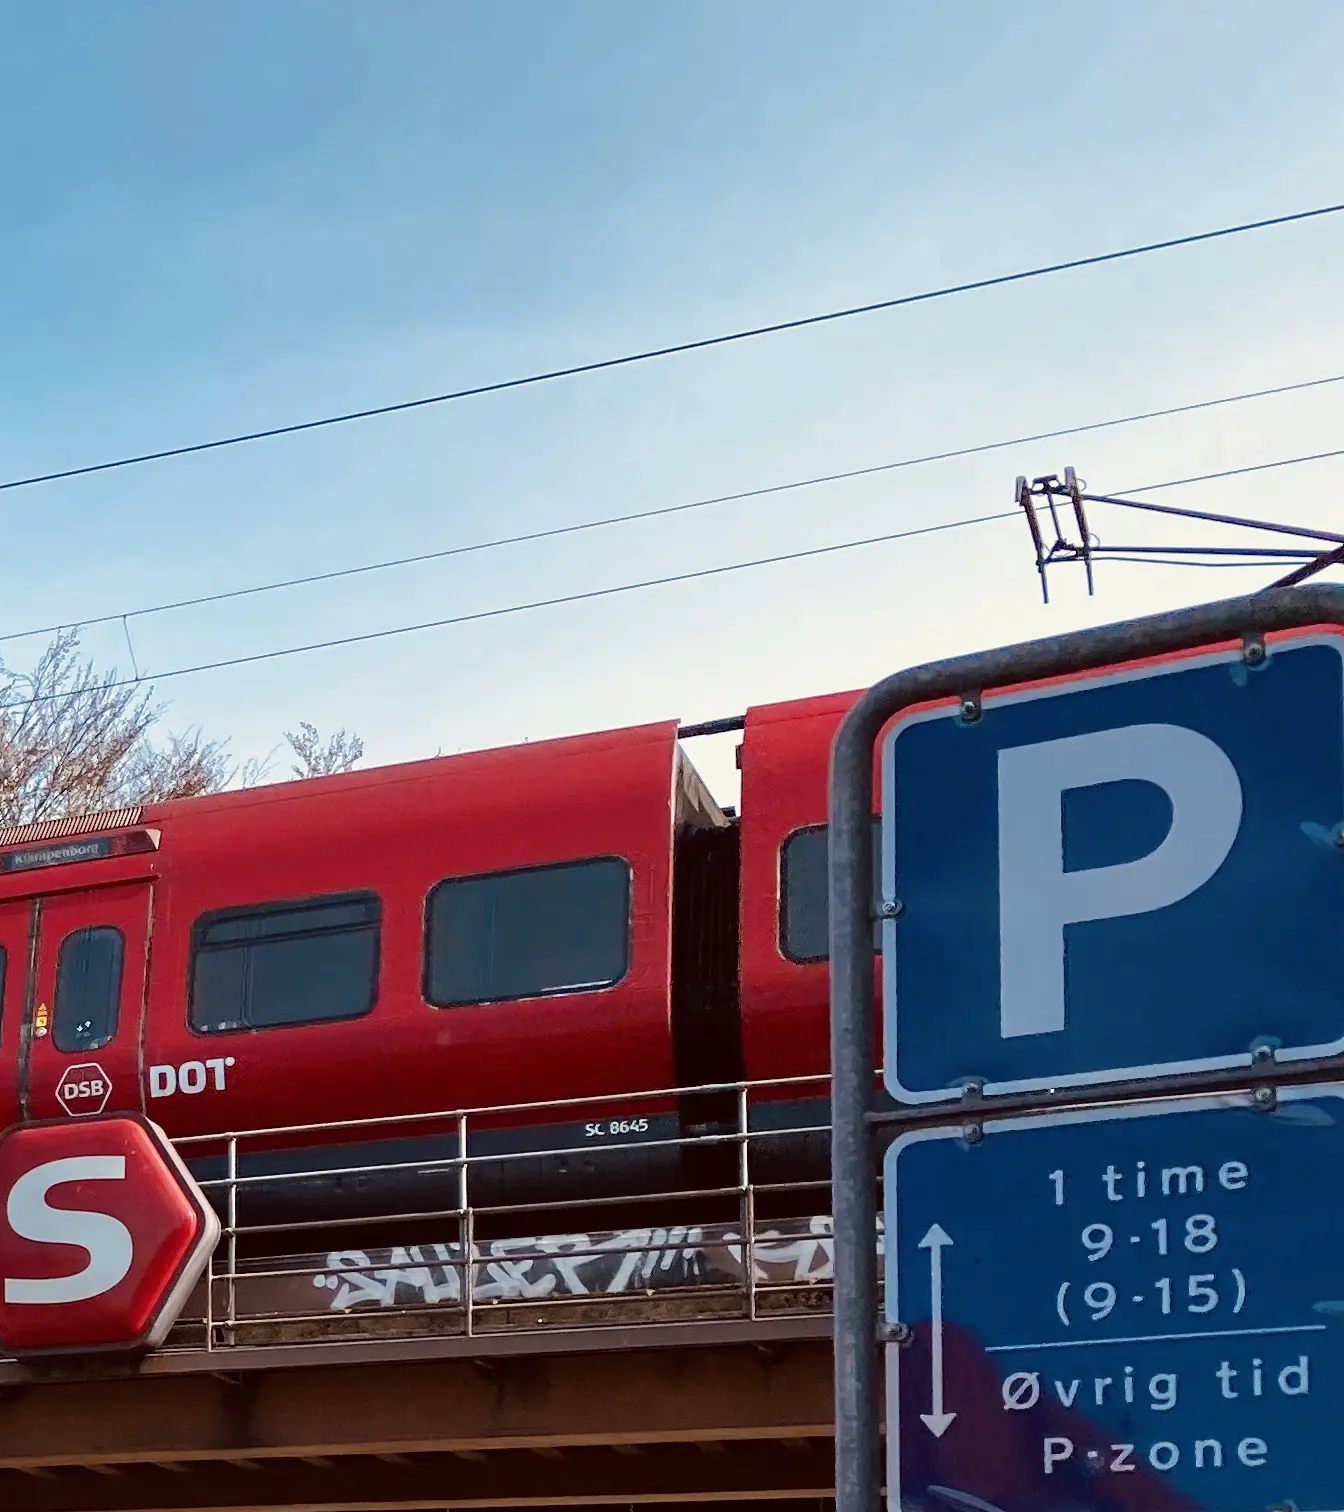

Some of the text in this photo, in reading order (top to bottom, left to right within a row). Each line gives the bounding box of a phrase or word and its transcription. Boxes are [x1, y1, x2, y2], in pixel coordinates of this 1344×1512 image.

[998, 723, 1243, 1038] P
[64, 1079, 104, 1100] DSB
[149, 1056, 235, 1099] DOT
[584, 1118, 649, 1137] SC 8645
[1048, 1160, 1249, 1206] 1 time
[4, 1155, 134, 1305] S
[1081, 1213, 1219, 1262] 9-18
[1057, 1267, 1247, 1327] (9-15)
[1001, 1356, 1310, 1411] Øvrig tid
[1043, 1436, 1269, 1474] P-zone
